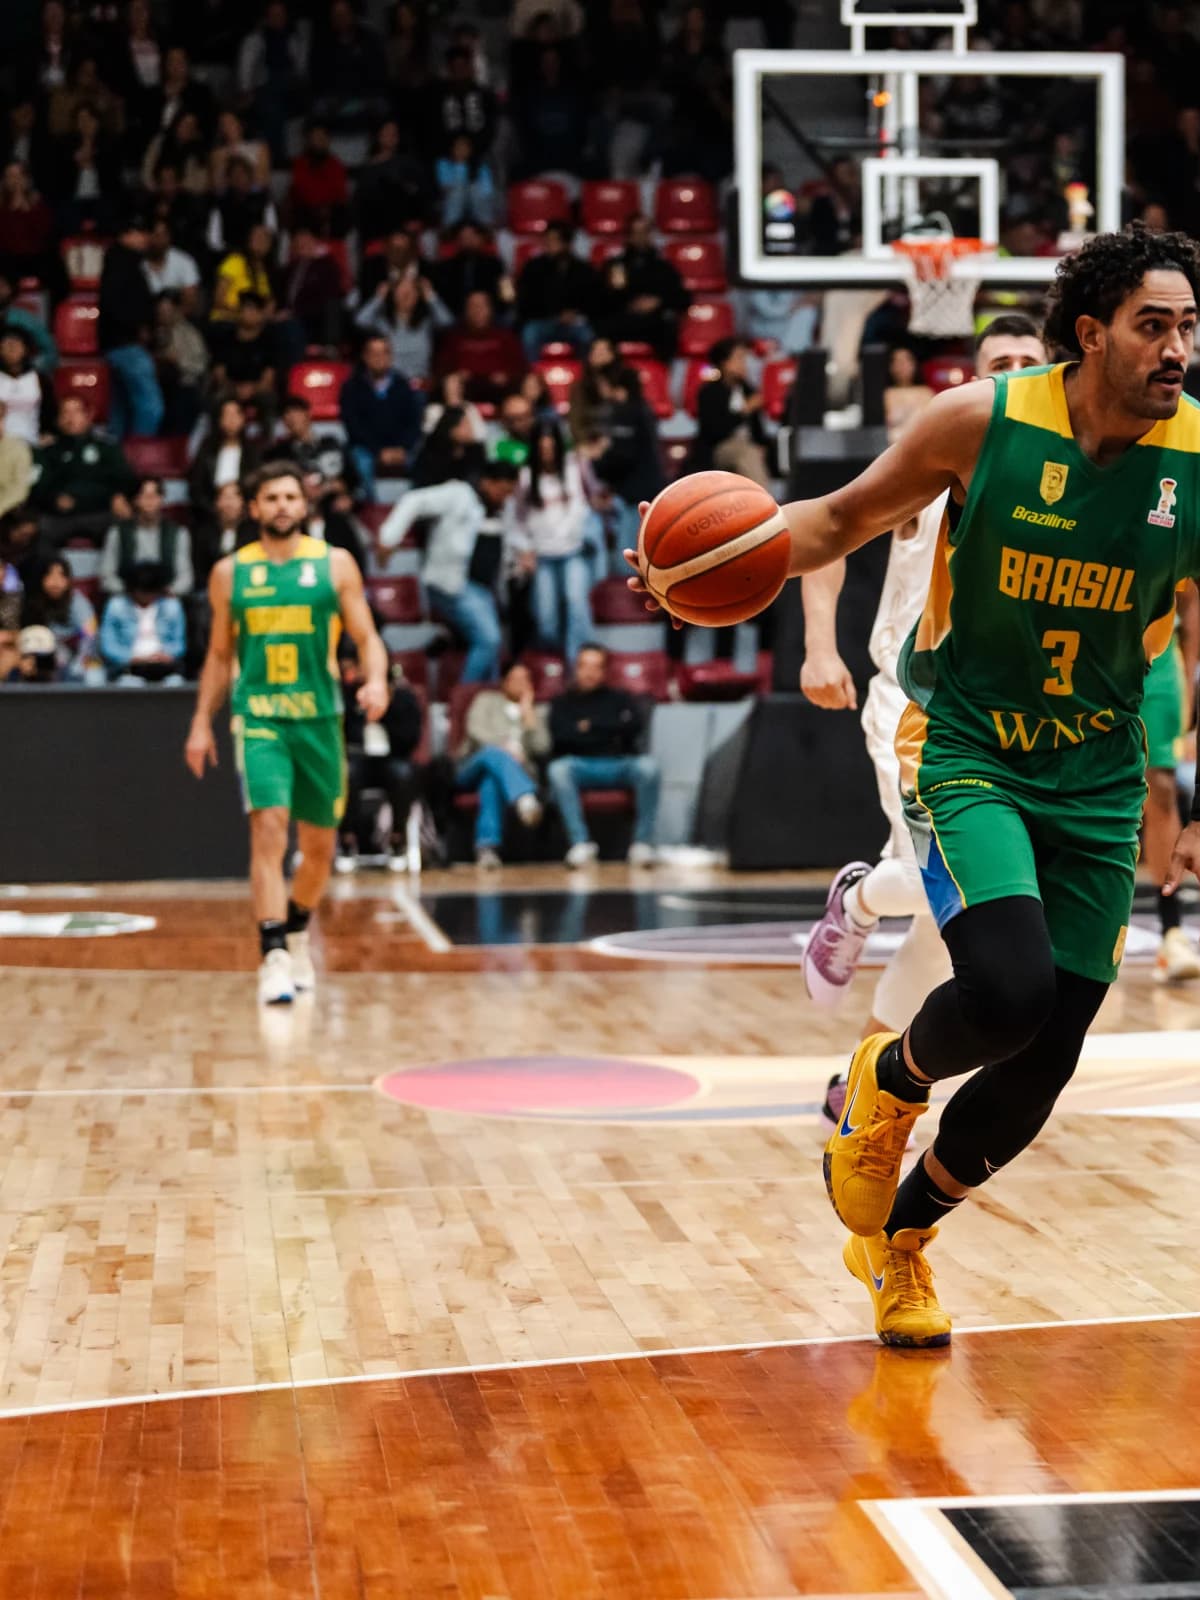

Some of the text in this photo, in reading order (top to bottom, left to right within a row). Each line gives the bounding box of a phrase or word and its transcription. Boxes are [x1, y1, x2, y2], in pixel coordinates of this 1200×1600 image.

[686, 497, 750, 537] molten
[1012, 505, 1077, 531] Braziline
[999, 546, 1135, 612] BRASIL
[266, 643, 299, 684] 19
[1042, 630, 1080, 695] 3
